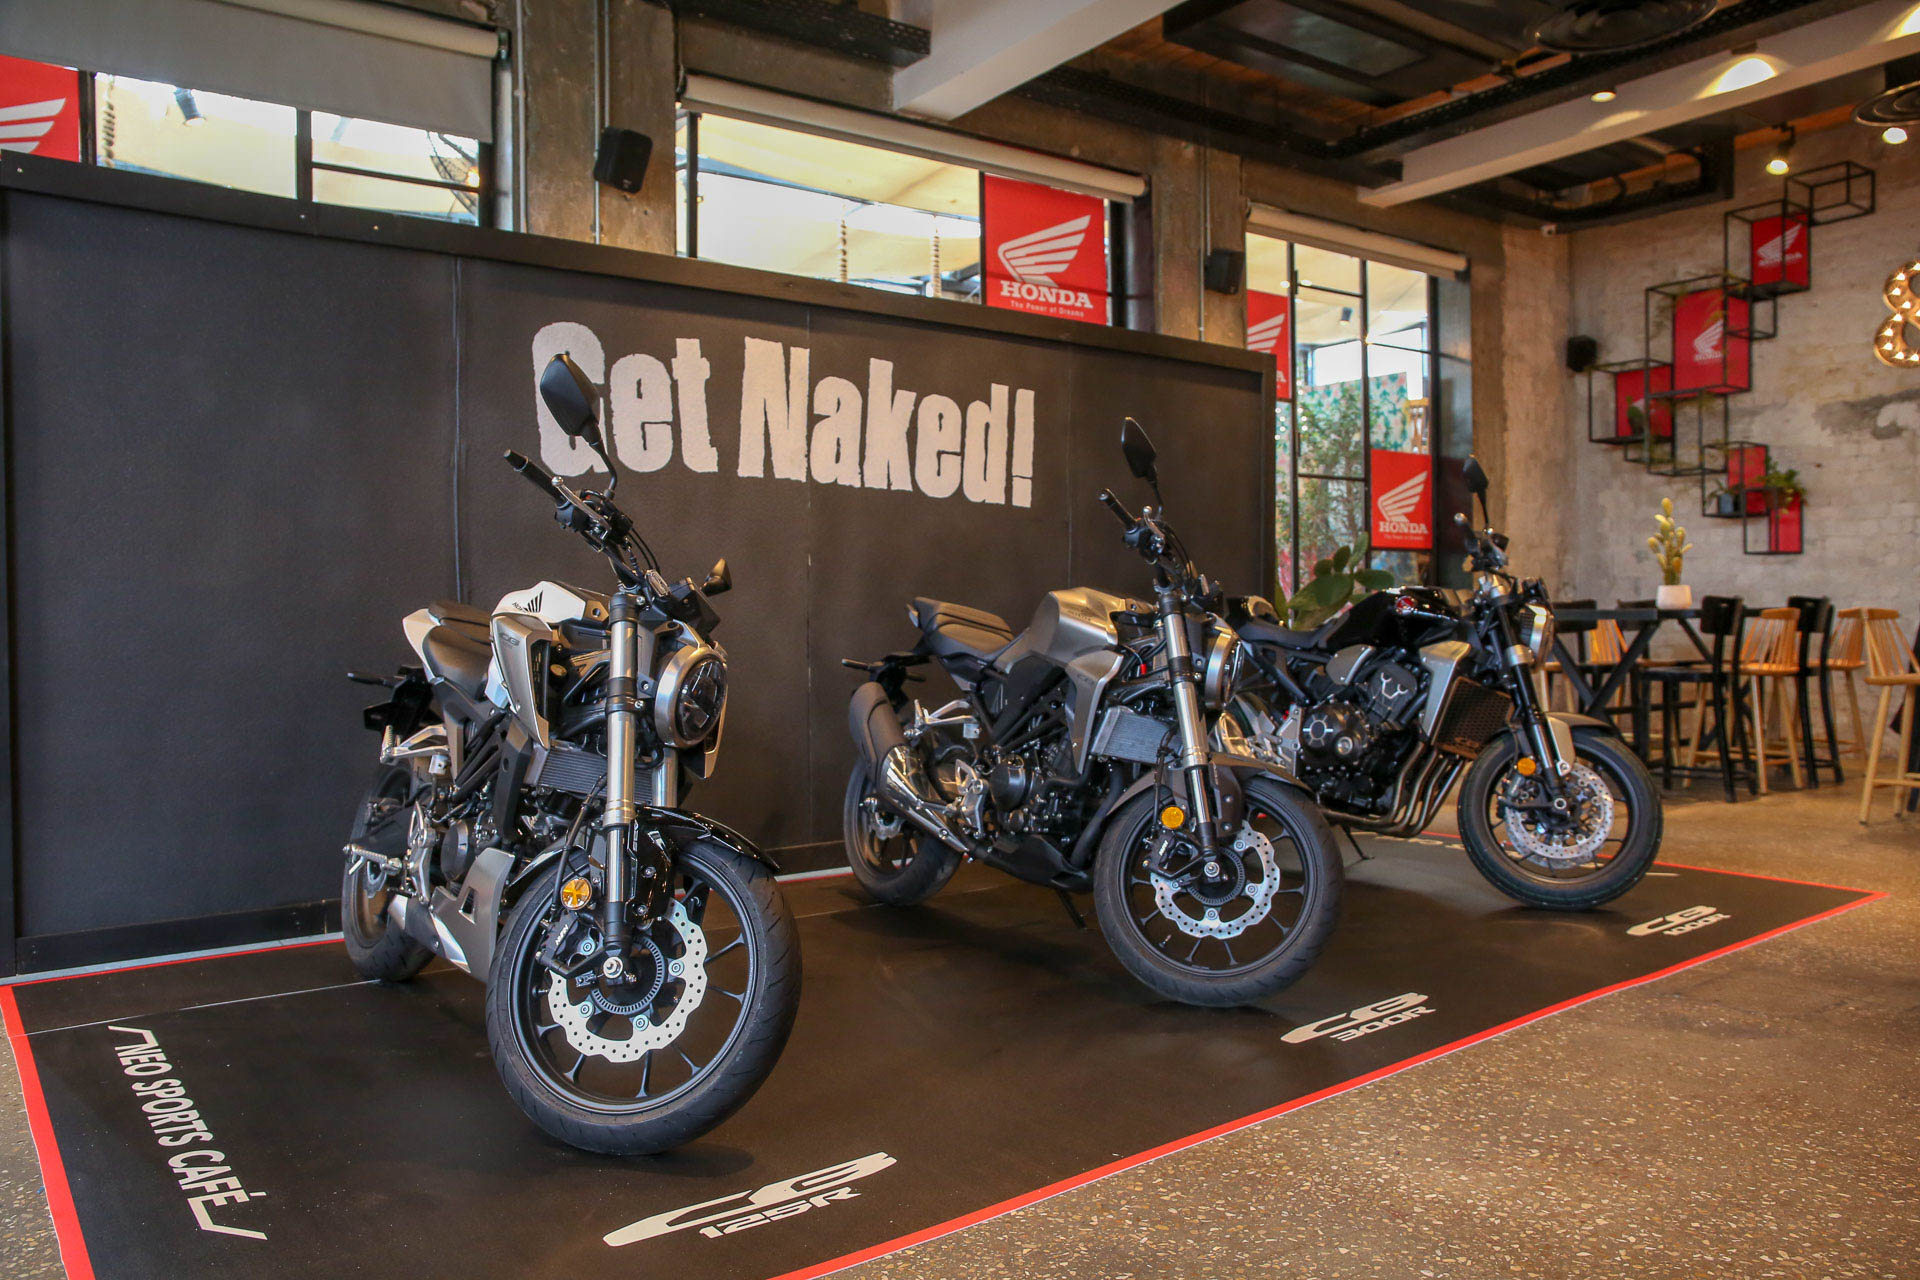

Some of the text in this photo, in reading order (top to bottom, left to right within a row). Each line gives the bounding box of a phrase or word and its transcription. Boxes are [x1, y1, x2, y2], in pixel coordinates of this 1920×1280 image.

[1000, 280, 1094, 309] HONDA
[532, 321, 1035, 508] Get Naked!
[1379, 521, 1429, 535] HONDA
[1626, 905, 1717, 936] CB
[1662, 913, 1732, 936] 1000R
[1280, 992, 1429, 1044] CB
[1330, 1006, 1437, 1042] 300R
[115, 1046, 173, 1076] NEO
[131, 1078, 214, 1147] SPORTS
[602, 1152, 898, 1247] CB
[700, 1186, 862, 1239] 125R
